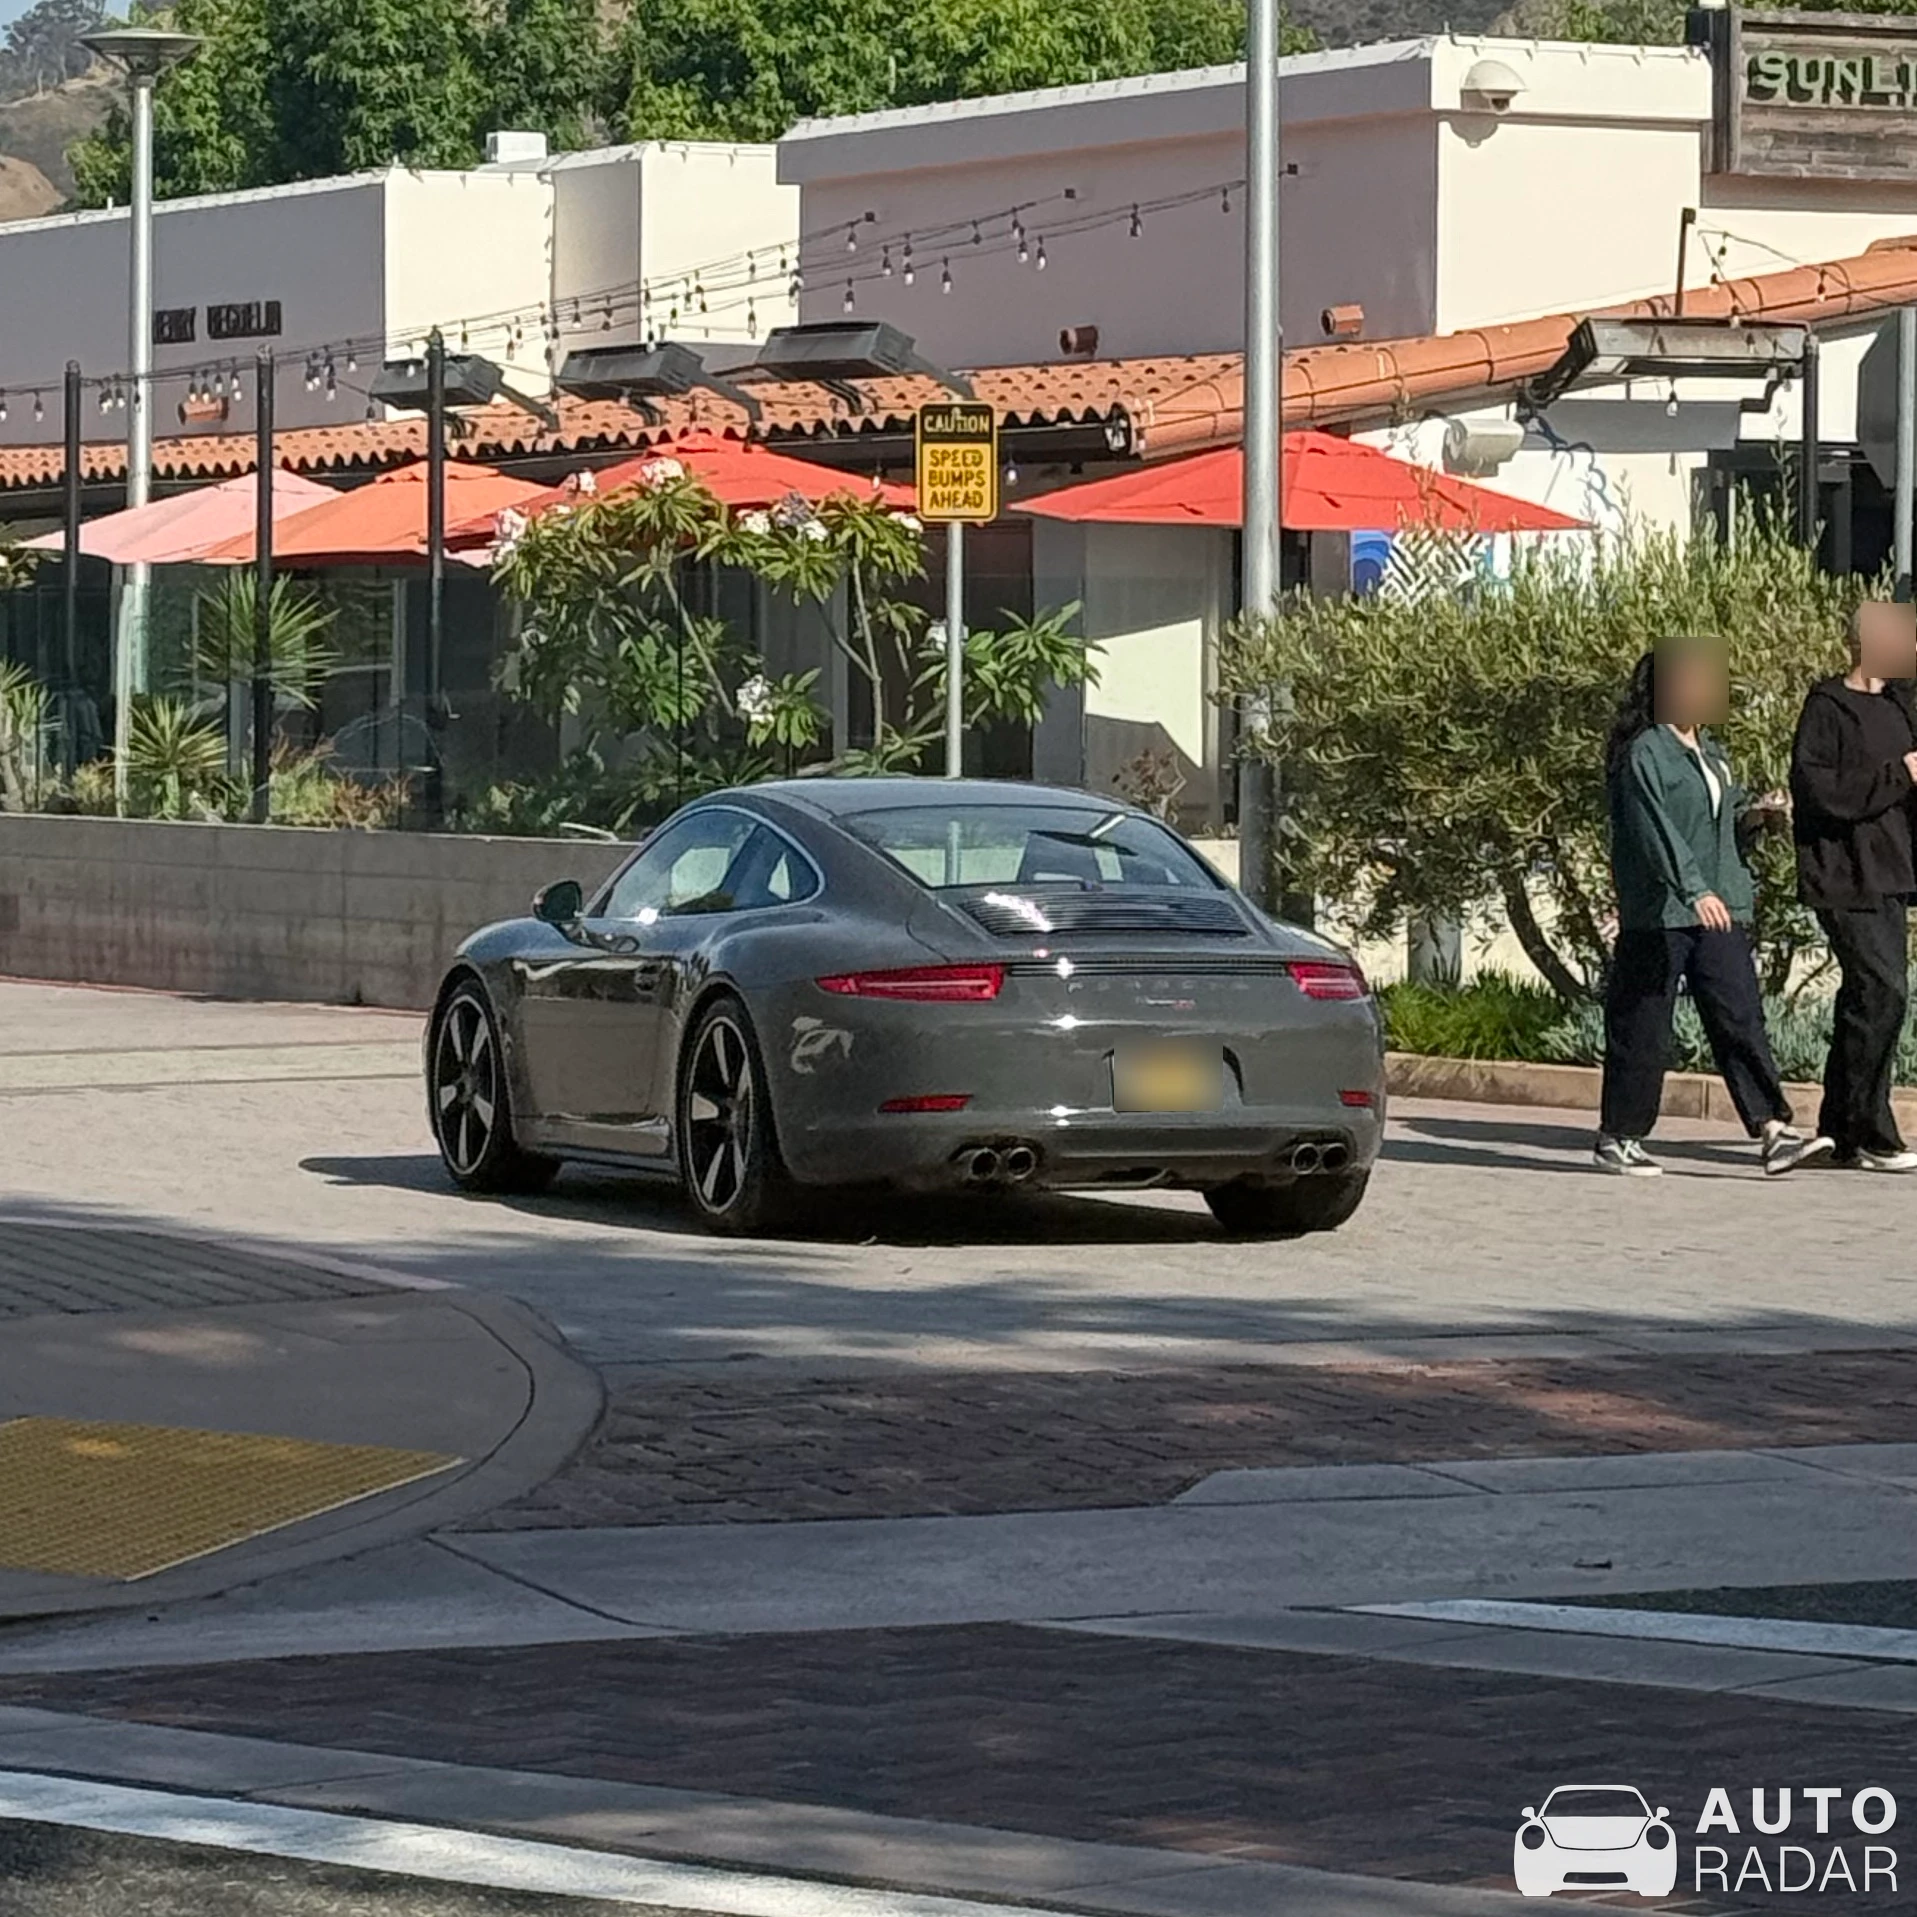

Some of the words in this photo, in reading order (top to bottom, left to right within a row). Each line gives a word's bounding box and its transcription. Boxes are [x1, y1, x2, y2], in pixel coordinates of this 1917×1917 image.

[1749, 50, 1917, 99] SUNLI
[924, 414, 990, 433] CAUTION
[929, 449, 984, 468] SPEED
[928, 469, 986, 488] BUMPS
[929, 490, 984, 509] AHEAD
